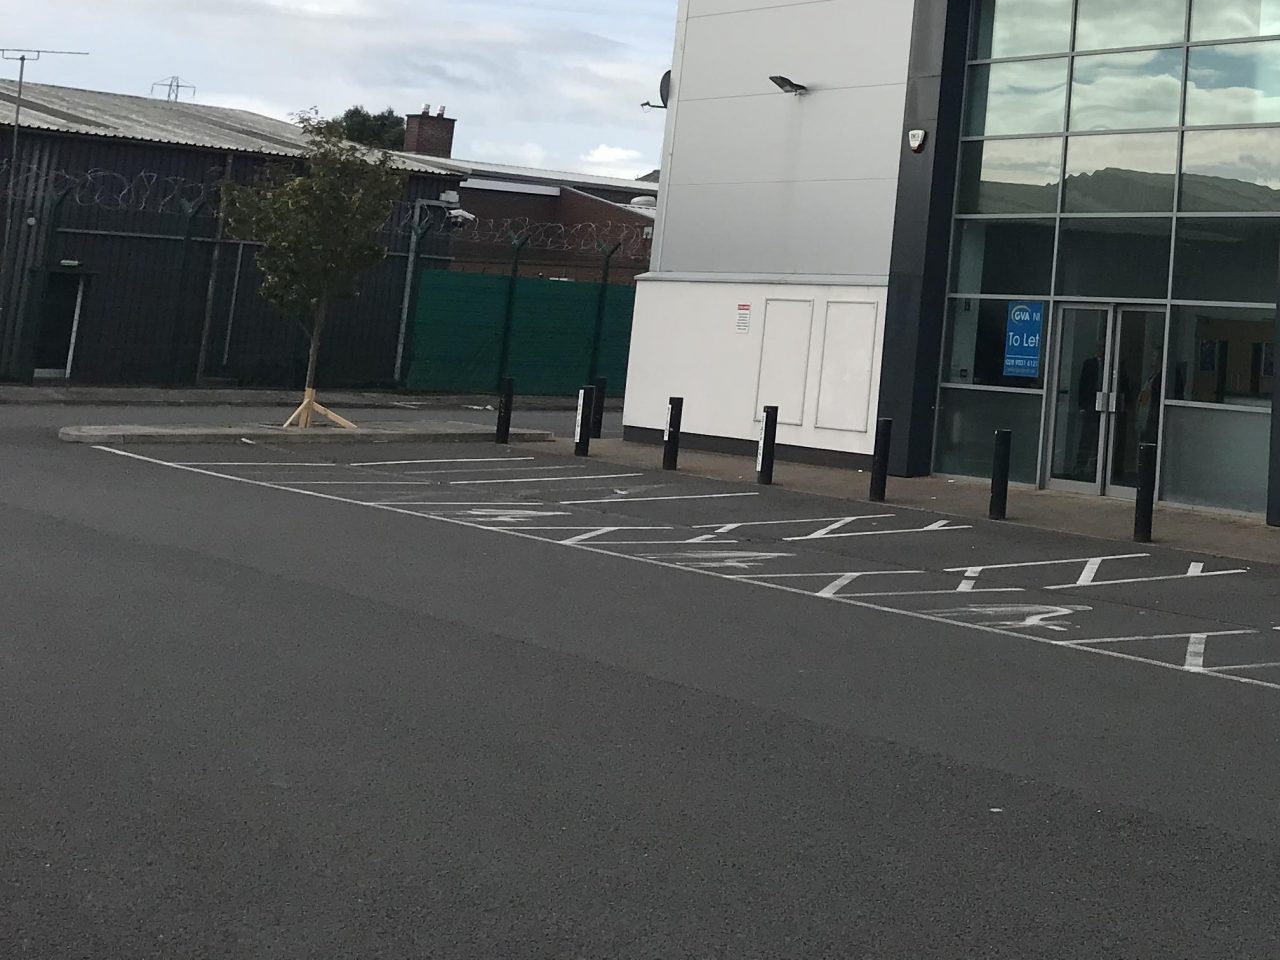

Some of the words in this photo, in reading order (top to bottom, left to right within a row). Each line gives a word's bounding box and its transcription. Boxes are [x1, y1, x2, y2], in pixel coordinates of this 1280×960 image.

[1014, 311, 1030, 321] GVA
[1009, 332, 1020, 347] To
[1023, 333, 1040, 347] Let
